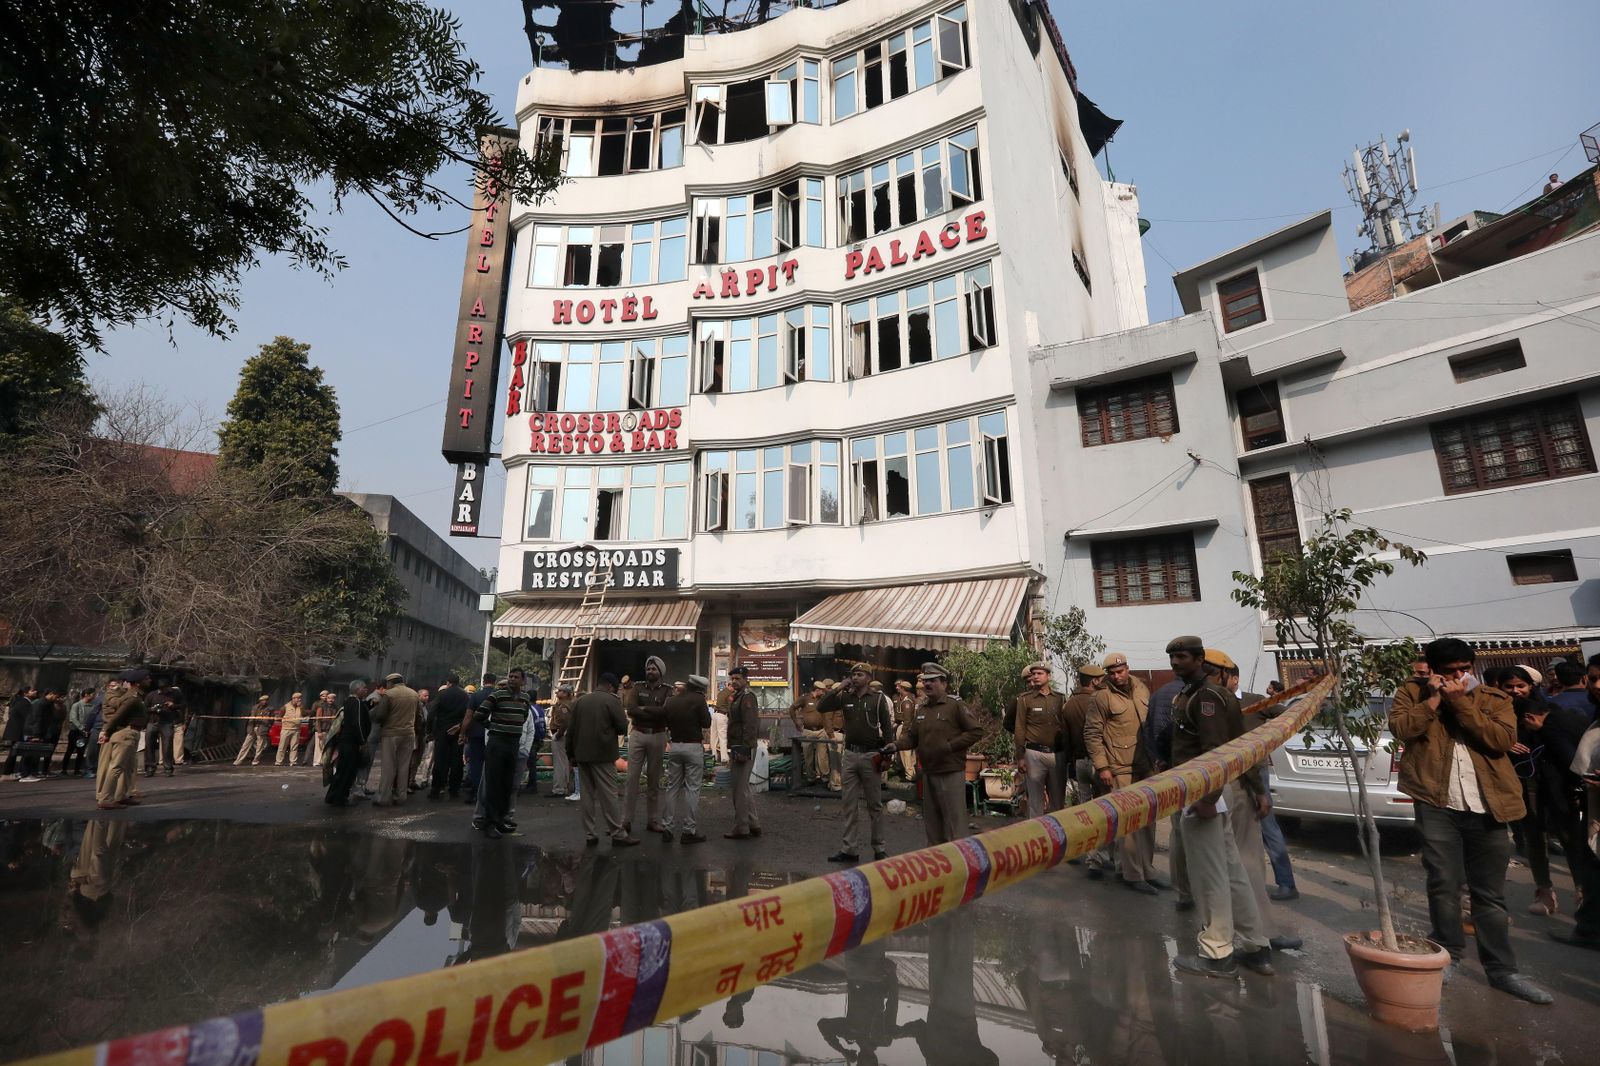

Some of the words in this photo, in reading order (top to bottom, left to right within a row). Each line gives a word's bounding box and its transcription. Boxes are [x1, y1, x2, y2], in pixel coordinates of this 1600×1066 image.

[552, 295, 658, 324] HOTEL
[692, 258, 799, 299] ARPIT
[844, 210, 989, 280] PALACE
[458, 297, 486, 430] ARPIT
[507, 340, 527, 416] BAR
[529, 408, 682, 434] CROSSROADS
[530, 431, 605, 454] RESTO
[609, 434, 625, 453] &
[631, 429, 678, 450] BAR
[457, 462, 476, 523] BAR
[532, 571, 597, 588] RESTO
[623, 570, 665, 587] BAR
[533, 550, 666, 568] CROSSROADS
[1301, 759, 1324, 767] DL9C
[874, 847, 952, 891] CROSS
[993, 836, 1049, 881] POLICE
[737, 895, 785, 932] पार
[893, 885, 945, 932] LINE
[716, 962, 745, 995] न
[756, 931, 804, 983] करें
